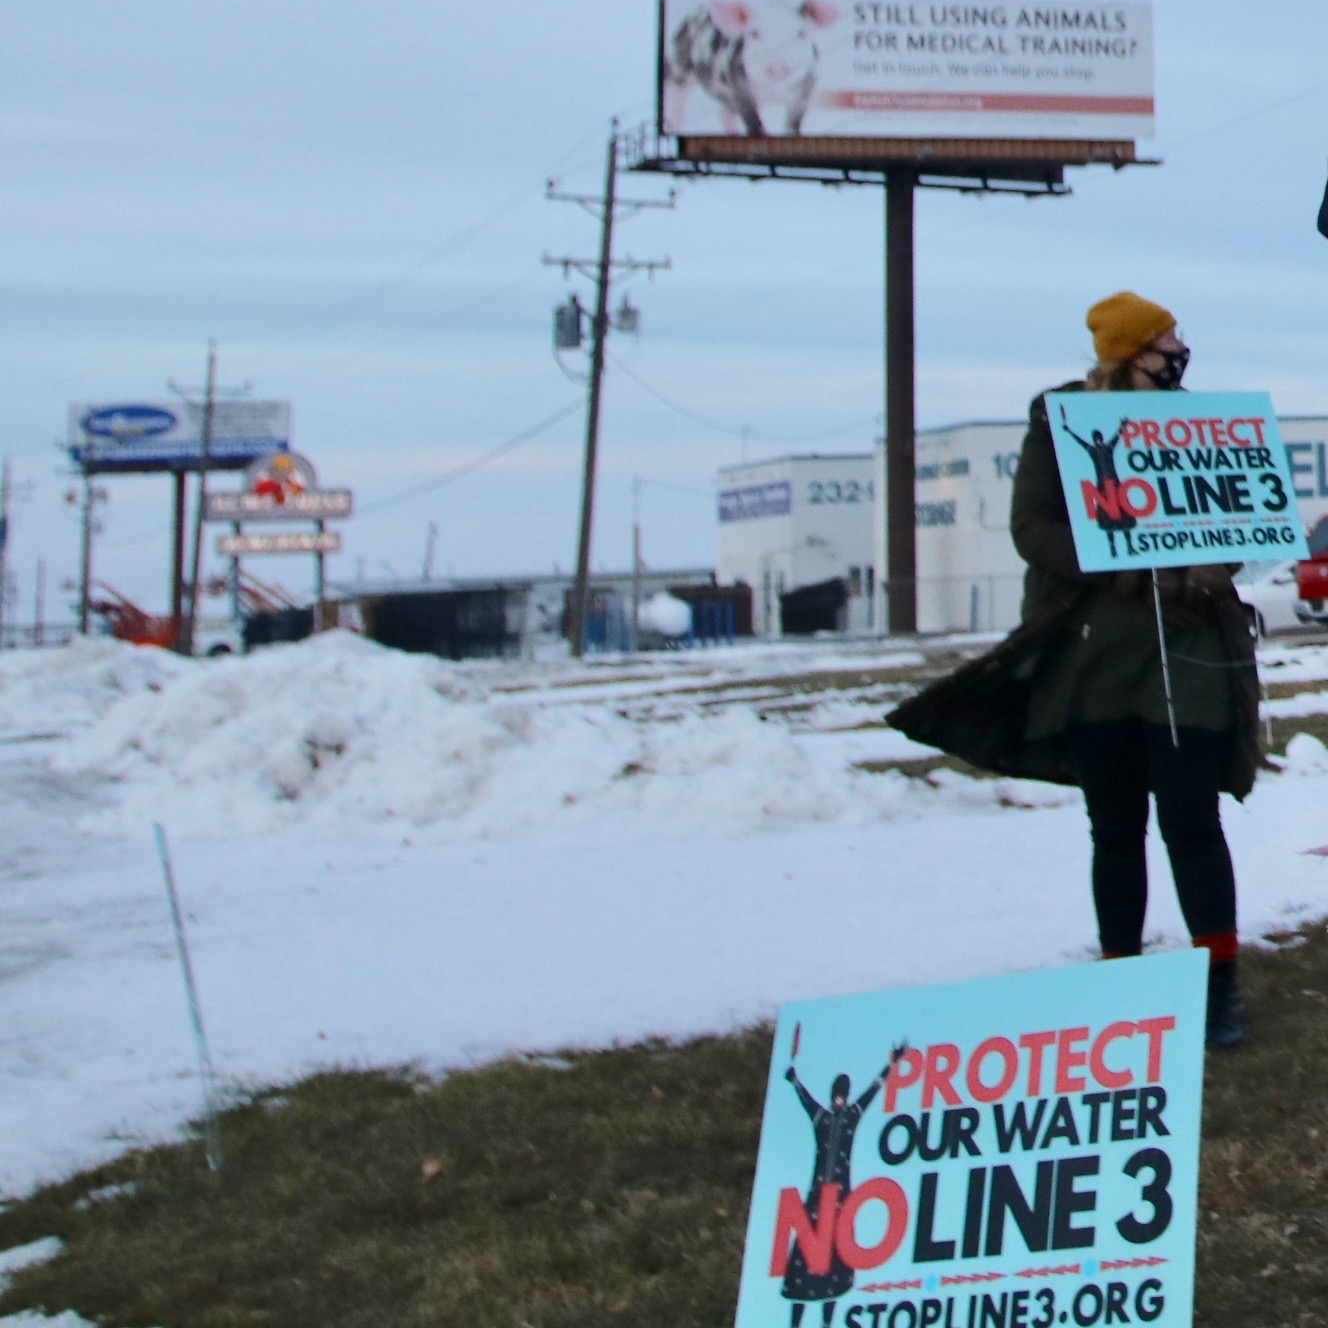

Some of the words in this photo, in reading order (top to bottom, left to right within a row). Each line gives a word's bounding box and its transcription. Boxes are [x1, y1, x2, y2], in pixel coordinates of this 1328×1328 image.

[853, 3, 922, 25] STILL
[930, 5, 1008, 28] USING
[1016, 8, 1127, 32] ANIMALS
[853, 30, 900, 52] FOR
[906, 32, 1009, 55] MEDICAL
[1017, 34, 1138, 59] TRAINING?
[1121, 417, 1266, 449] PROTECT
[1128, 449, 1183, 472] OUR
[1186, 447, 1276, 471] WATER
[1080, 477, 1158, 521] NO
[1157, 474, 1254, 516] LINE
[1258, 473, 1288, 513] 3
[1136, 526, 1296, 553] STOPLINE3.ORG
[884, 1016, 1177, 1114] PROTECT
[878, 1106, 982, 1166] OUR
[993, 1086, 1171, 1154] WATER
[769, 1176, 910, 1278] NO
[912, 1155, 1102, 1264] LINE
[1115, 1147, 1174, 1245] 3
